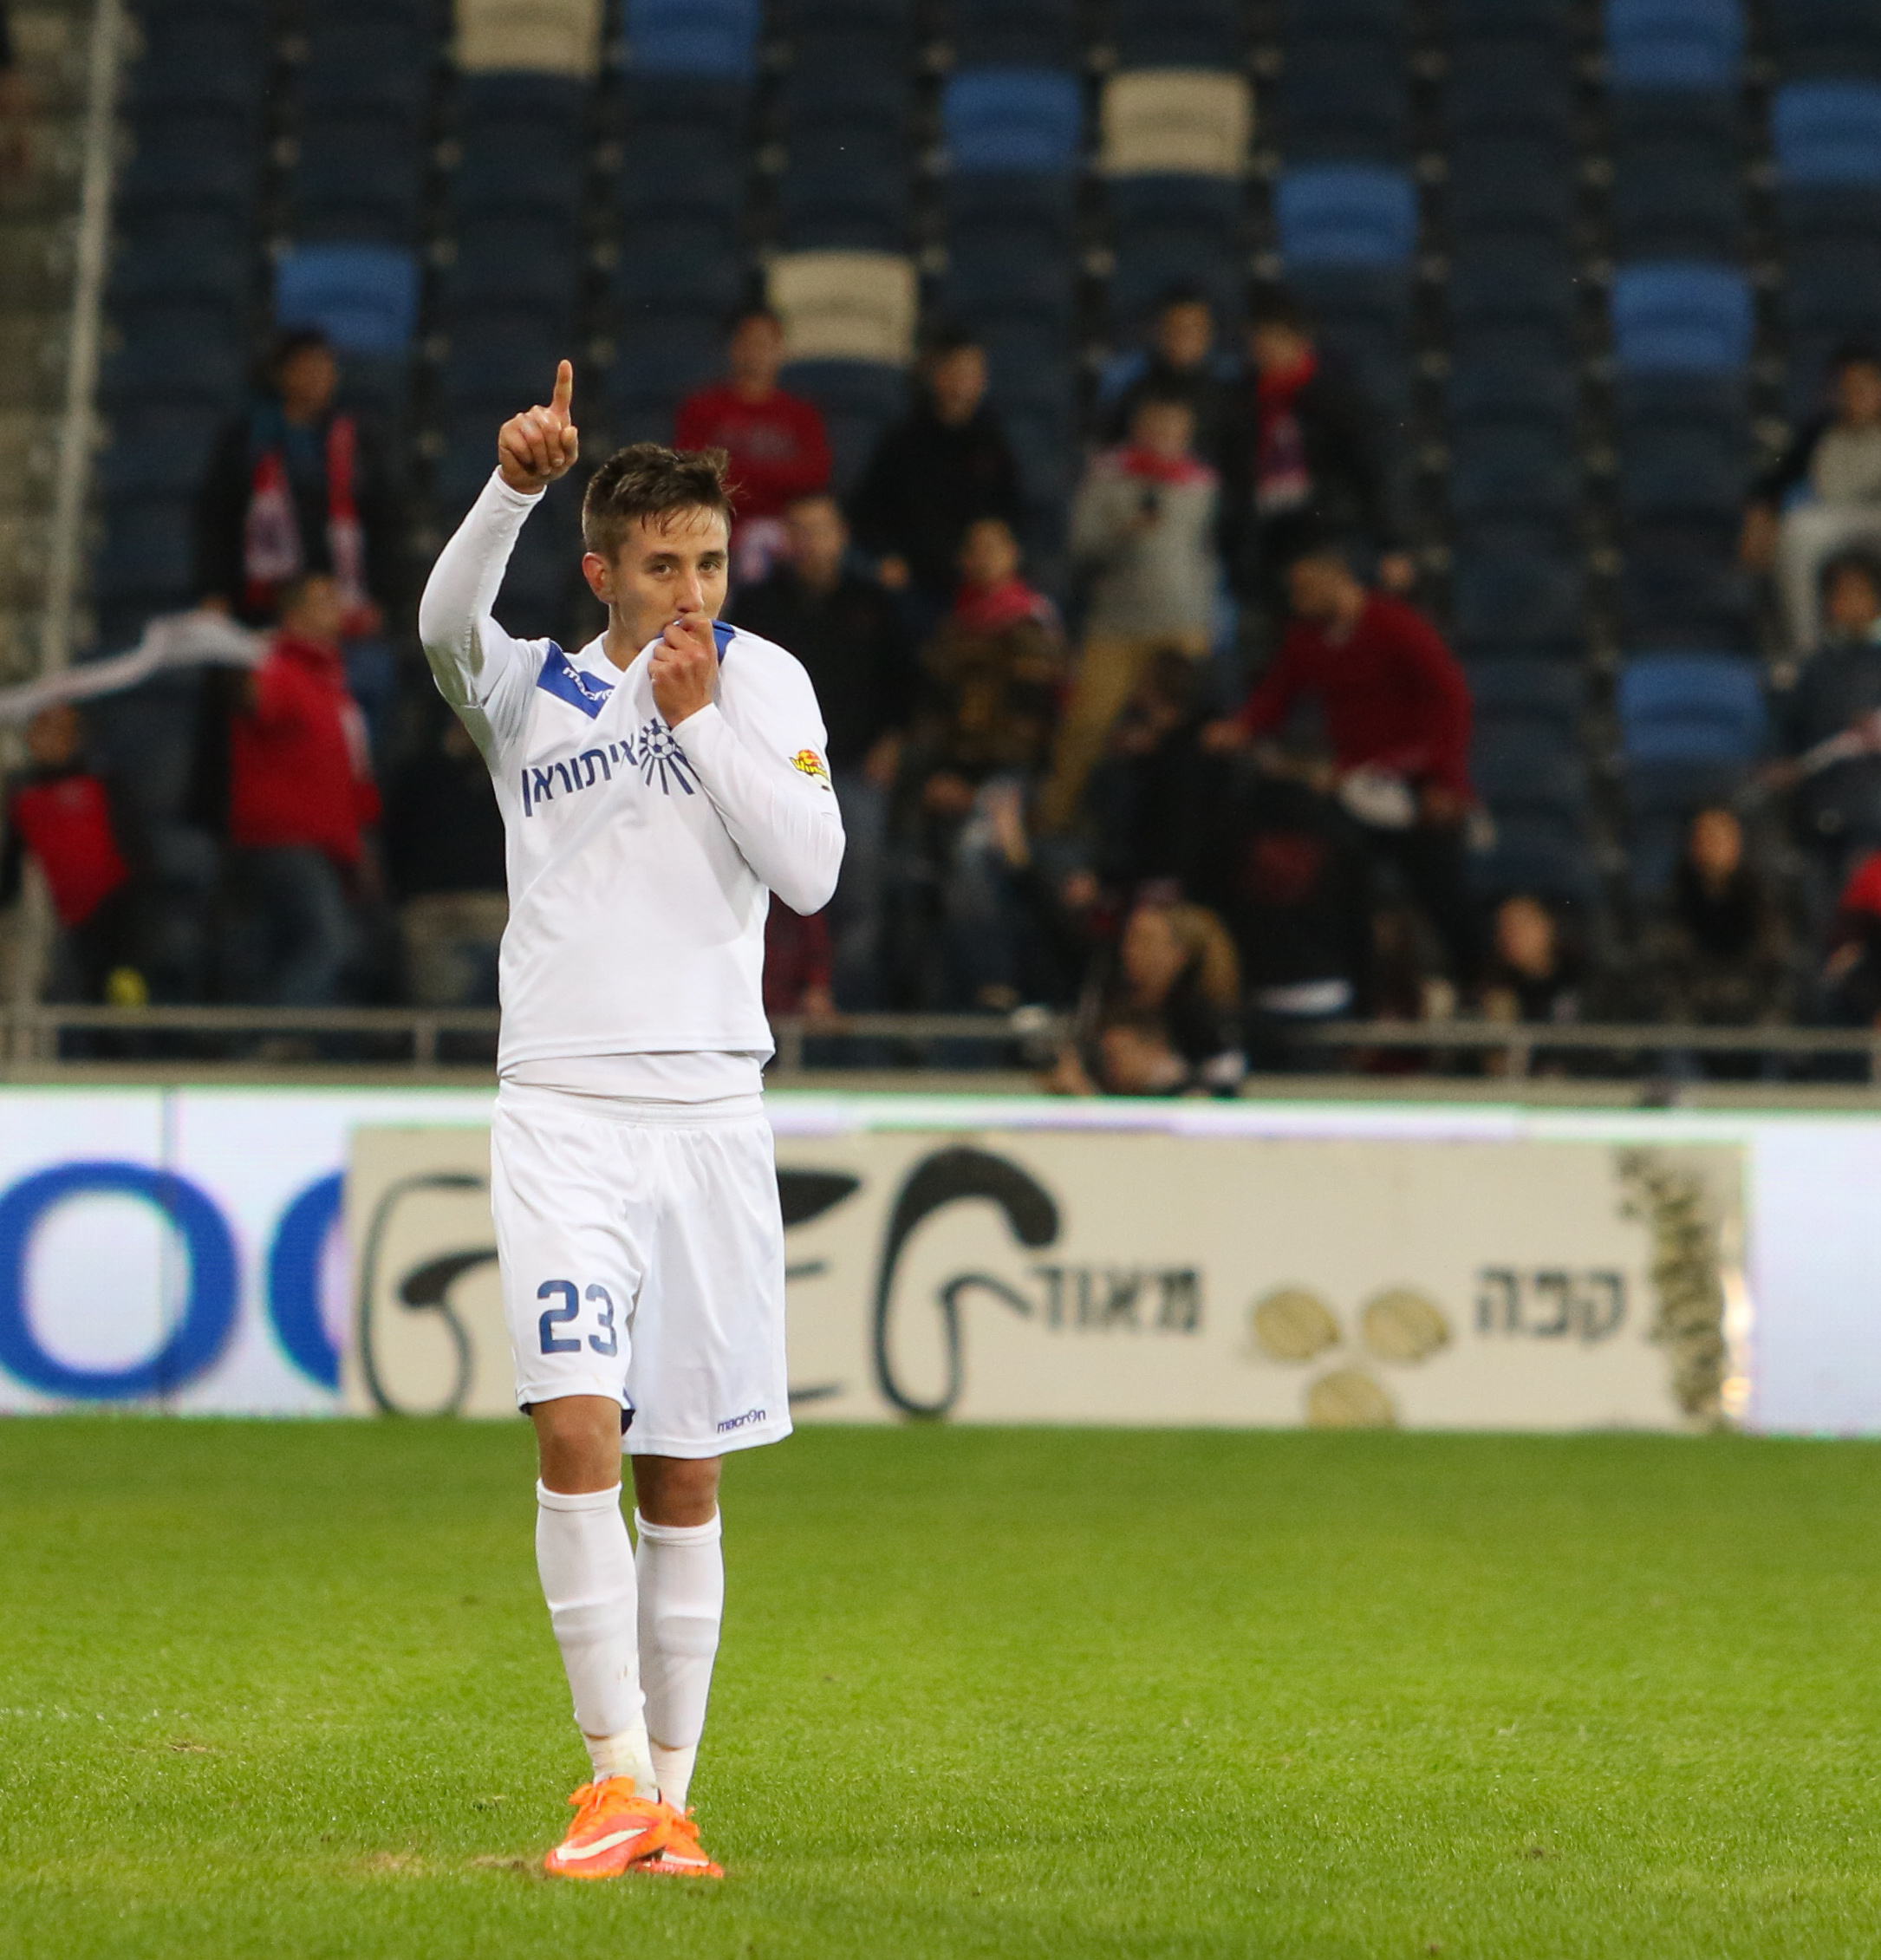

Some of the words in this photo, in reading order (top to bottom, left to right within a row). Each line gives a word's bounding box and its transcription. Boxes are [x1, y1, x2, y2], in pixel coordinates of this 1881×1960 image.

[563, 667, 614, 701] macro
[521, 733, 638, 817] איתוראן
[537, 1279, 617, 1357] 23
[1037, 1264, 1198, 1333] מאוד
[1474, 1267, 1626, 1346] קפה
[716, 1409, 766, 1435] macron
